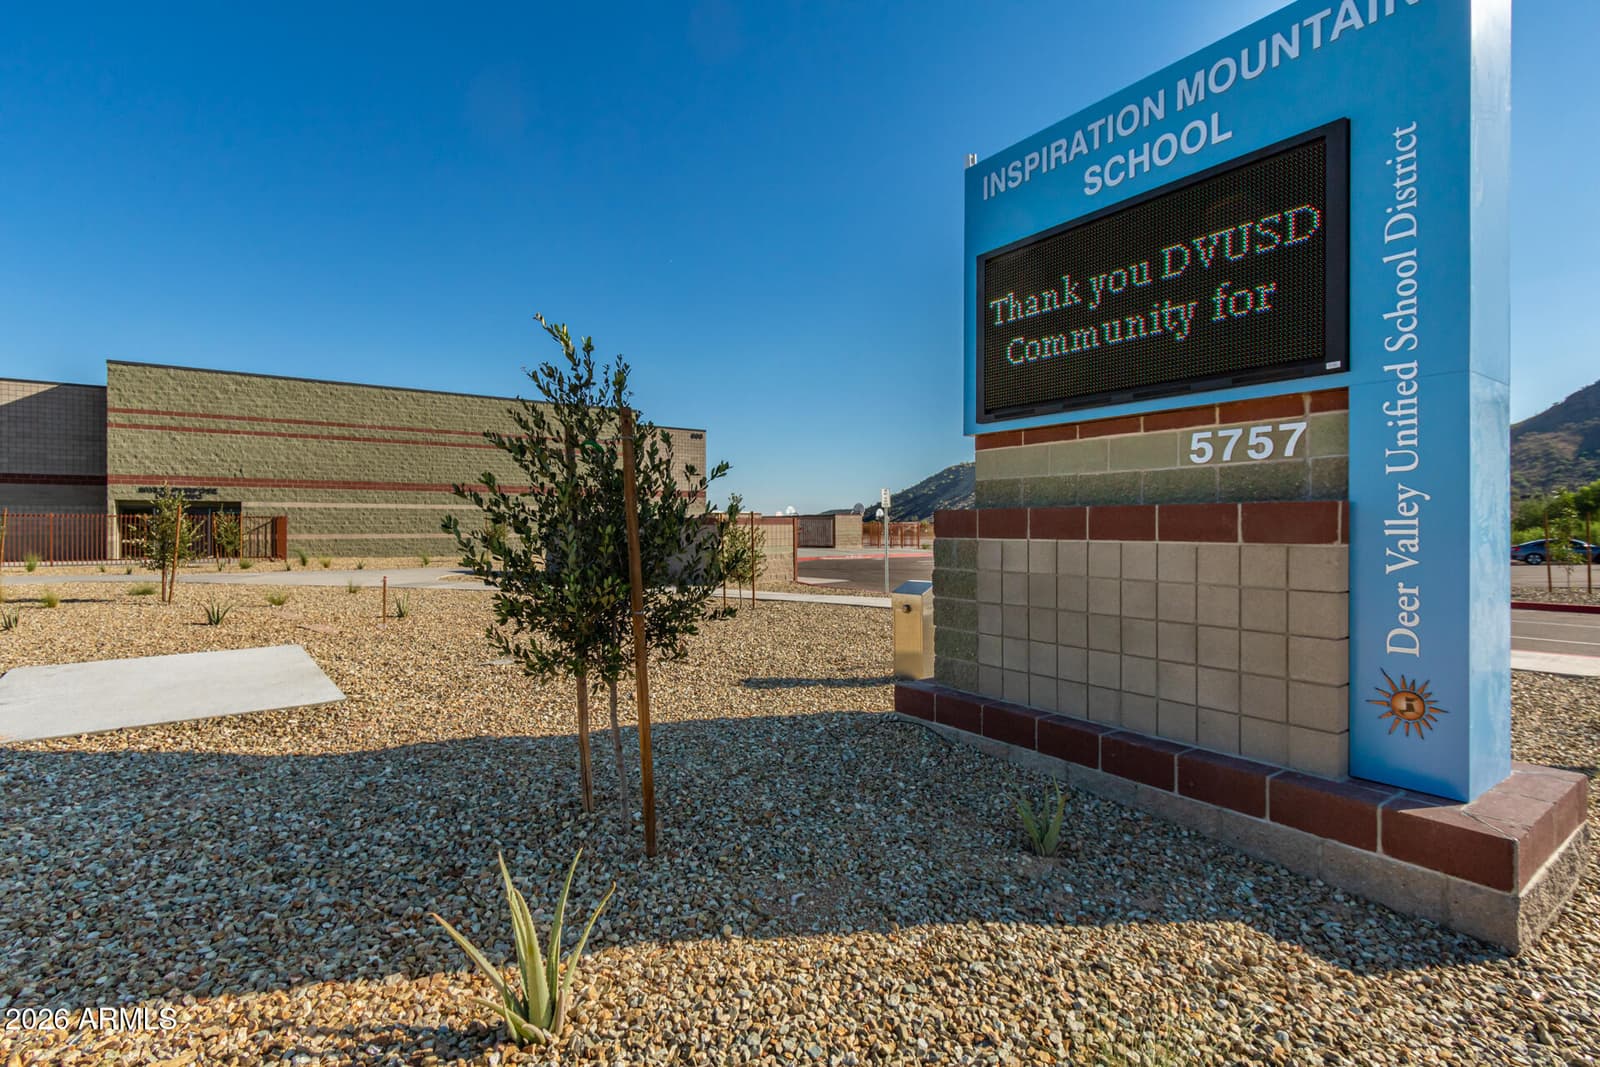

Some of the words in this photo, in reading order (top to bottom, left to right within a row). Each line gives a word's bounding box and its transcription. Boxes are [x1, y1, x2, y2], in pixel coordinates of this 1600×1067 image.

[983, 89, 1166, 200] INSPIRATION
[1176, 0, 1419, 112] MOUNTAI
[1083, 112, 1233, 196] SCHOOL
[1384, 121, 1418, 244] District
[989, 274, 1083, 326] Thank
[1088, 261, 1152, 311] you
[1161, 203, 1322, 280] DVUSD
[1382, 248, 1418, 352] School
[1006, 300, 1199, 365] Community
[1210, 281, 1277, 322] for
[1189, 422, 1307, 464] 5757
[1382, 360, 1419, 475] Unified
[1384, 483, 1431, 575] Valley
[1386, 582, 1420, 658] Deer
